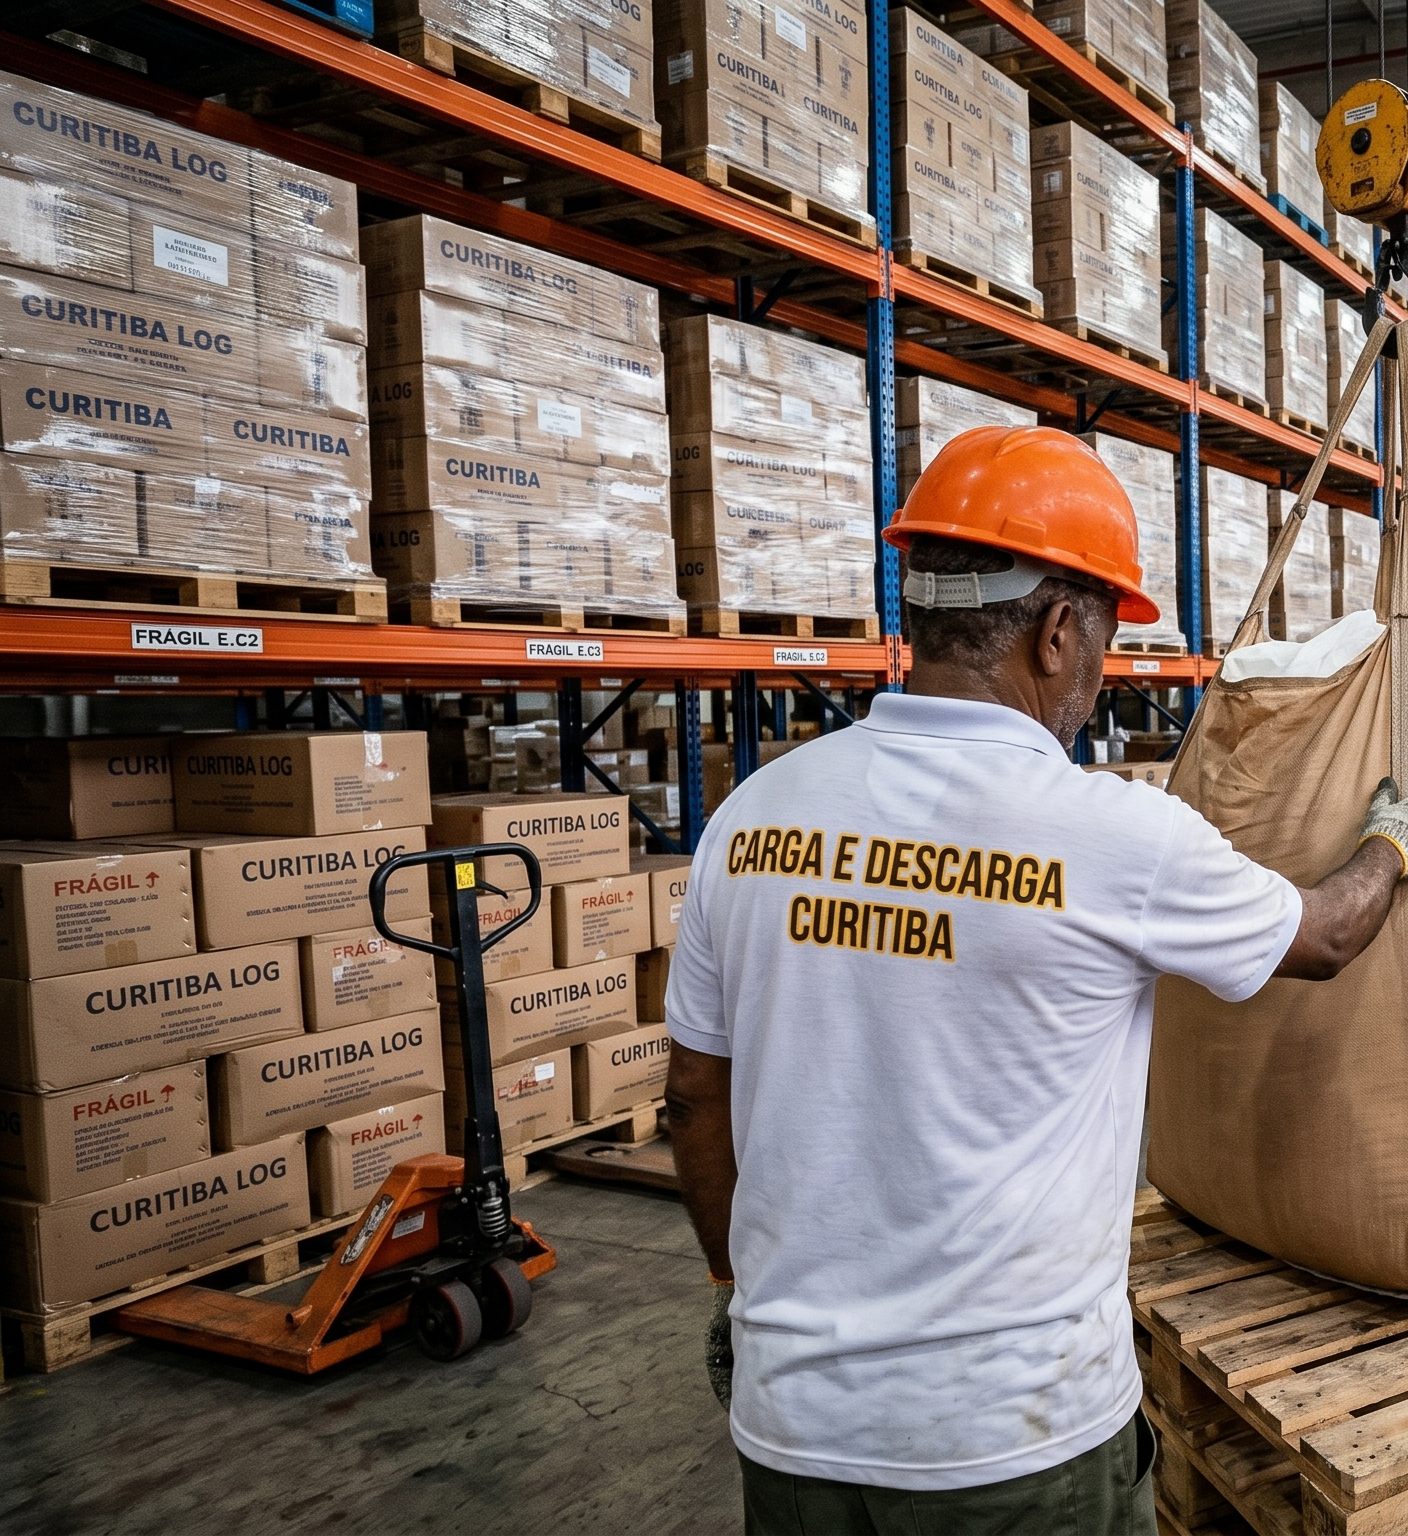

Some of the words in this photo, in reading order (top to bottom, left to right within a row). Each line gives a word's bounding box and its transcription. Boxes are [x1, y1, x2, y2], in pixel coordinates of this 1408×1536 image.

[834, 11, 858, 35] LOG
[916, 26, 964, 67] CURITIBA
[717, 52, 780, 98] CURITIBA
[914, 69, 960, 106] CURITIBA
[963, 99, 983, 119] LOG
[12, 101, 163, 165] CURITIBA
[171, 147, 229, 183] LOG
[914, 160, 956, 192] CURITIBA
[439, 239, 537, 283] CURITIBA
[20, 294, 170, 343] CURITIBA
[177, 324, 234, 355] LOG
[24, 386, 173, 431] CURITIBA
[233, 419, 351, 457] CURITIBA
[445, 457, 542, 489] CURITIBA
[134, 626, 210, 647] FRÁGIL
[216, 631, 260, 648] E.C2
[528, 643, 574, 657] FRAGIL
[577, 645, 602, 658] E.C3
[108, 755, 169, 776] CURI
[187, 755, 257, 778] CURITIBA
[259, 755, 293, 777] LOG
[506, 815, 587, 839] CURITIBA
[590, 810, 621, 830] LOG
[241, 850, 358, 883] CURITIBA
[725, 827, 824, 877] CARGA
[832, 832, 861, 884] E
[863, 837, 1067, 912] DESCARGA
[53, 872, 140, 897] FRÁGIL
[582, 889, 625, 910] FRÁGIL
[788, 894, 957, 963] CURITIBA
[85, 971, 223, 1016] CURITIBA
[229, 960, 281, 990] LOG
[510, 985, 592, 1015] CURITIBA
[595, 973, 628, 998] LOG
[261, 1040, 375, 1084] CURITIBA
[380, 1026, 424, 1055] LOG
[611, 1037, 670, 1067] CURITIB
[72, 1089, 155, 1121] FRÁGIL
[350, 1118, 409, 1146] FRÁGIL
[89, 1175, 229, 1233] CURITIBA
[236, 1156, 287, 1191] LOG
